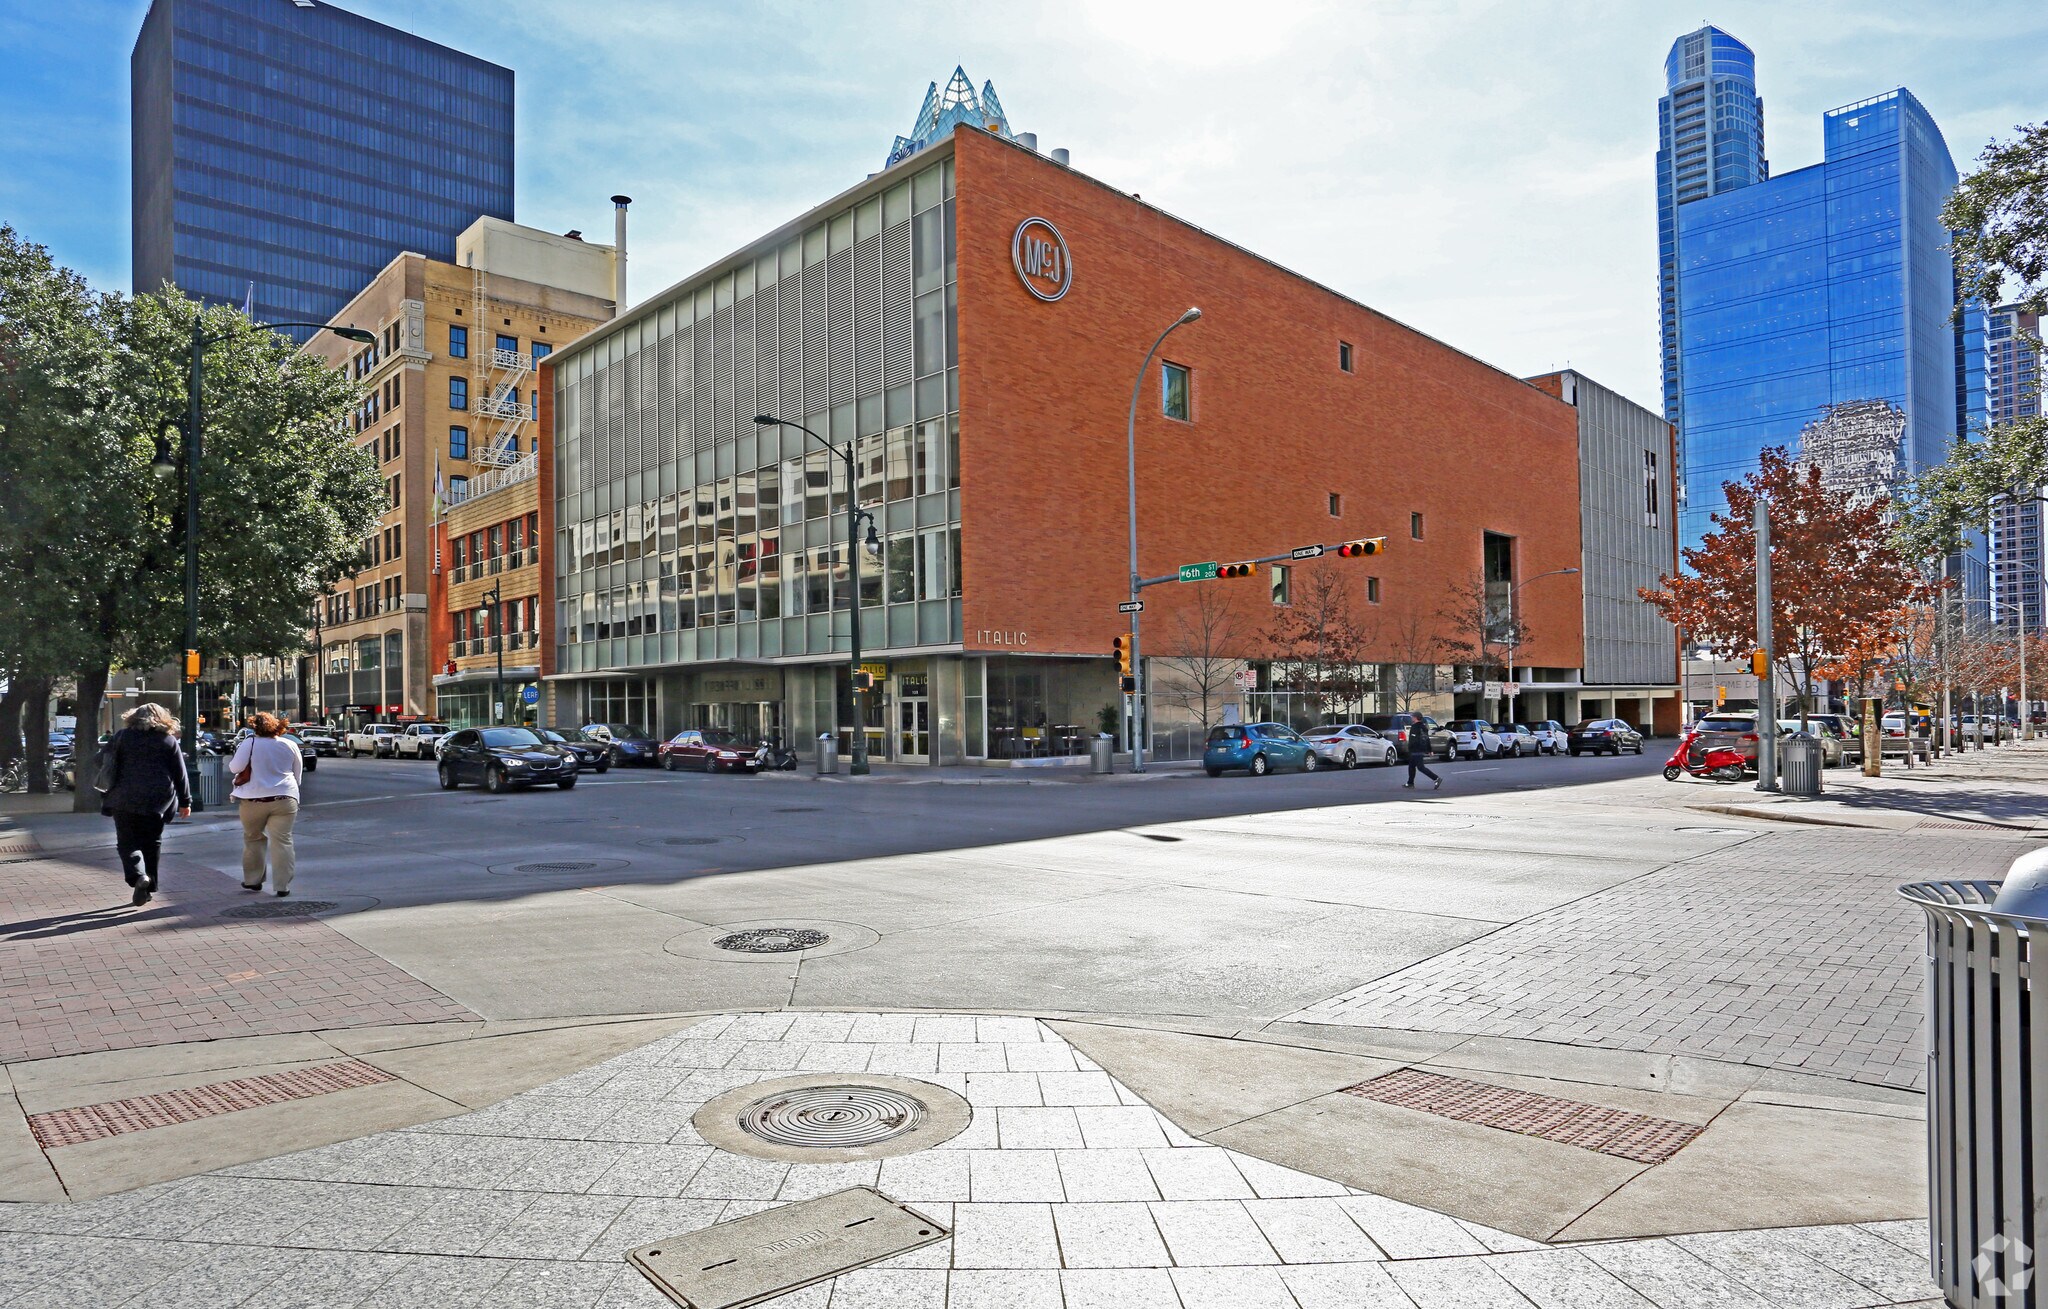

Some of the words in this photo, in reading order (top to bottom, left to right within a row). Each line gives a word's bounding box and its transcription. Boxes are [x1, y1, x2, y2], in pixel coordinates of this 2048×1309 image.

[1185, 567, 1200, 578] 6th
[1204, 570, 1215, 578] 200
[977, 629, 1027, 646] ITALIC
[902, 676, 928, 685] ITALIC
[523, 691, 538, 699] LEAF
[762, 1231, 823, 1254] ELECTRIC
